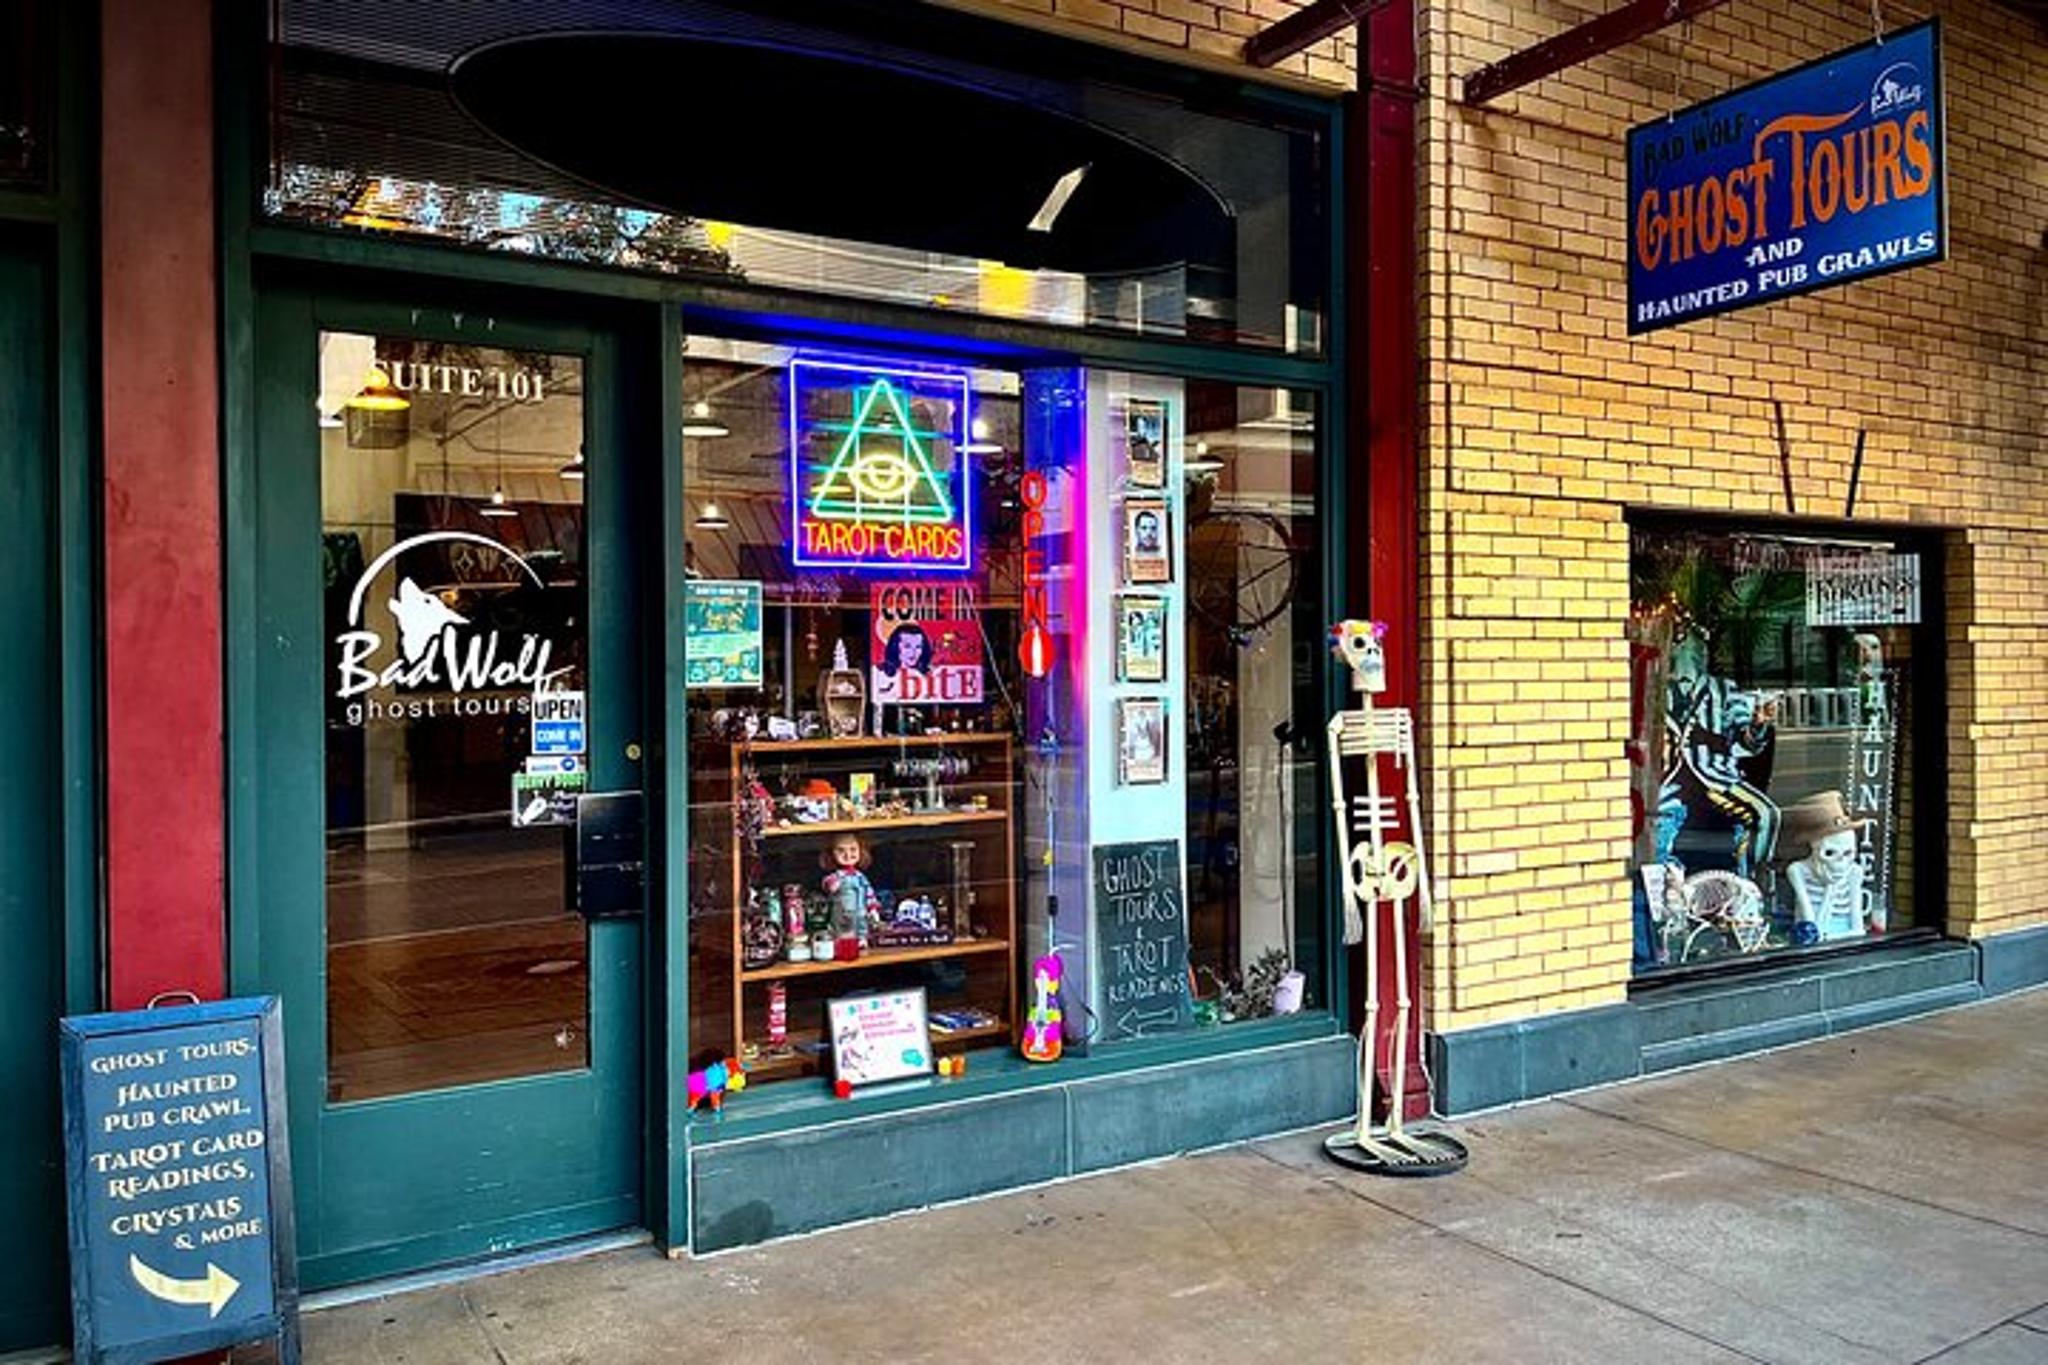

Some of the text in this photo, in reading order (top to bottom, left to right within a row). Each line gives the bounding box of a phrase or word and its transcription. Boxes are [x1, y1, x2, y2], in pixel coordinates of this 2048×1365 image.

[1636, 103, 1934, 271] GHOST TOURS
[1745, 237, 1804, 267] AND
[1637, 279, 1749, 323] HAUNTED
[1757, 263, 1809, 293] PUB
[492, 371, 545, 401] 101
[803, 522, 963, 558] TAROT CARDS
[1020, 470, 1047, 630] OPEN
[881, 586, 977, 621] COME IN
[336, 625, 576, 702] Bad Wolf
[346, 696, 532, 725] ghost tours
[1103, 848, 1168, 894] GHOST
[1109, 888, 1179, 926] TOURS
[1110, 935, 1177, 977] TAROT
[91, 1049, 168, 1075] GHOST
[118, 1073, 237, 1107] HAUNTED
[104, 1111, 156, 1132] PUB
[90, 1129, 265, 1172] TAROT CARD
[110, 1196, 242, 1235] CRYSTALS
[173, 1217, 263, 1250] & MORE
